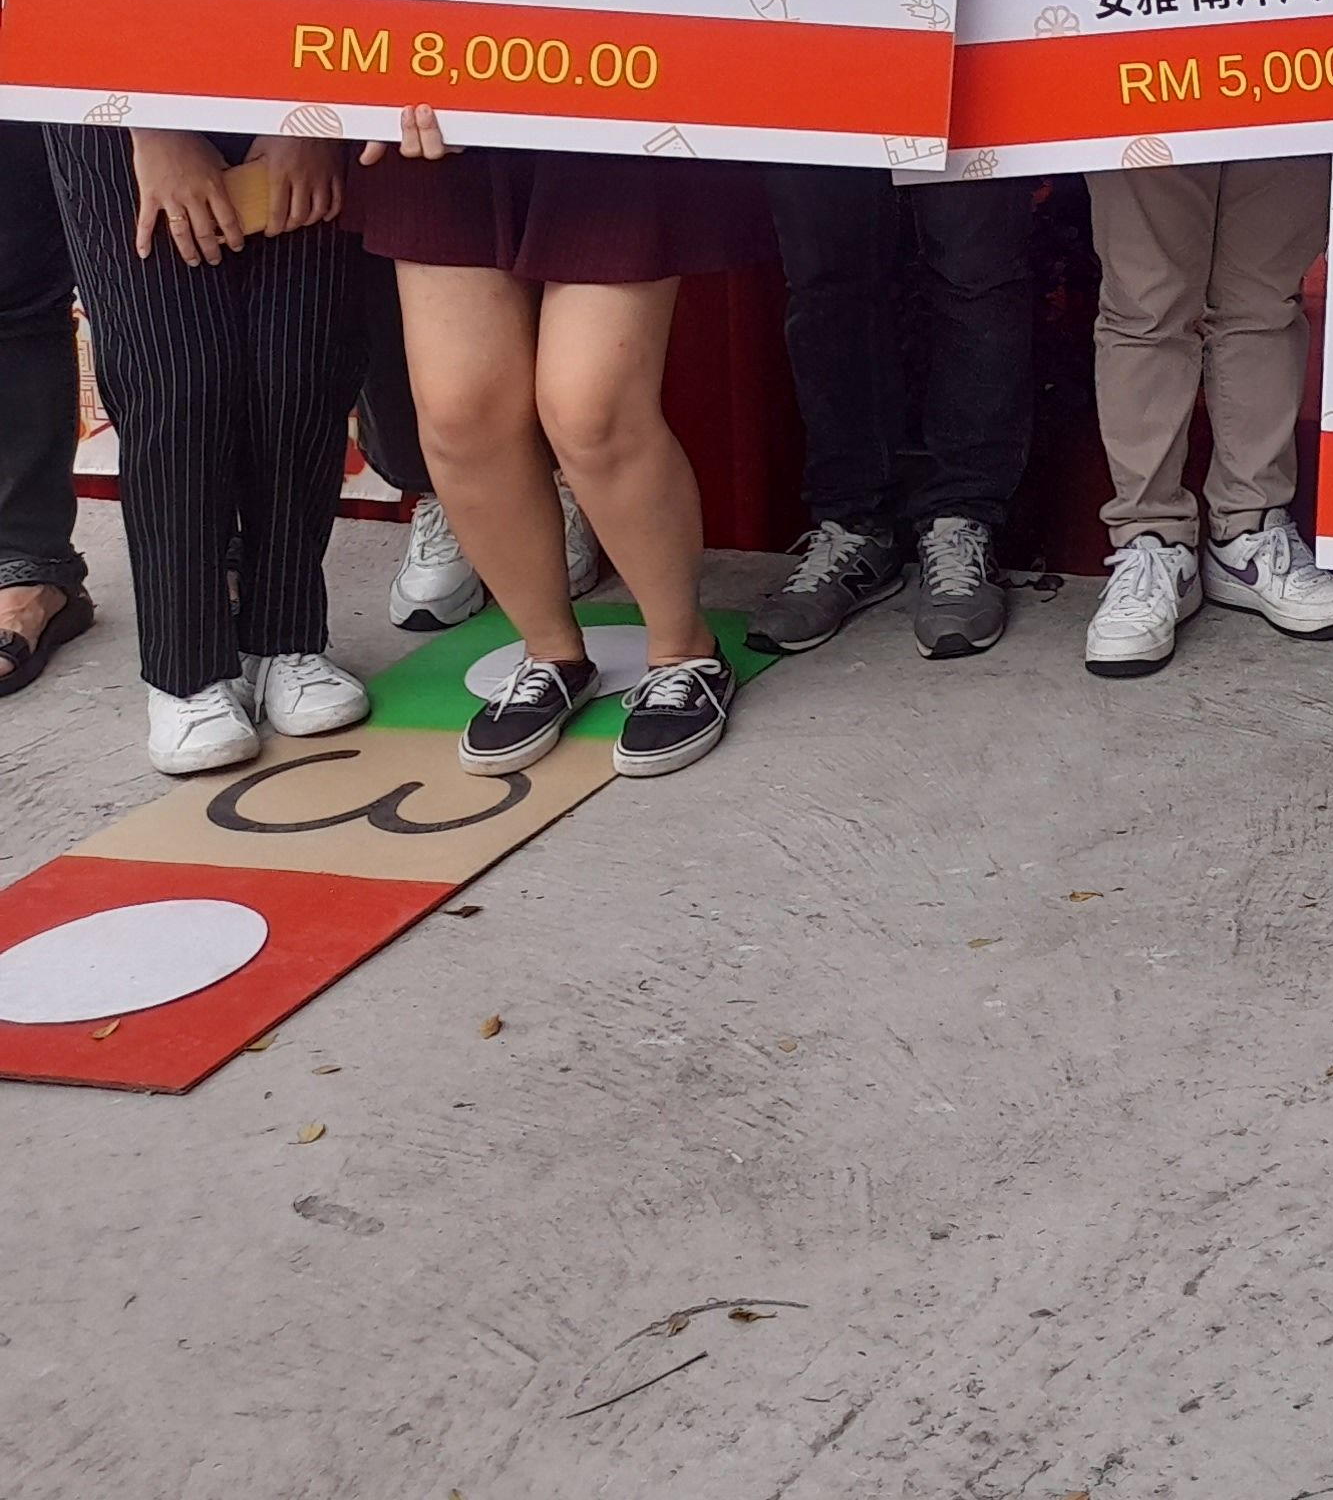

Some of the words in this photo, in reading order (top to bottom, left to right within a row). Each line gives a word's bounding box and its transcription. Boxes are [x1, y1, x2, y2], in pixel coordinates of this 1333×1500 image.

[292, 24, 390, 75] RM
[411, 30, 659, 90] 8,000.00
[1119, 58, 1200, 105] RM
